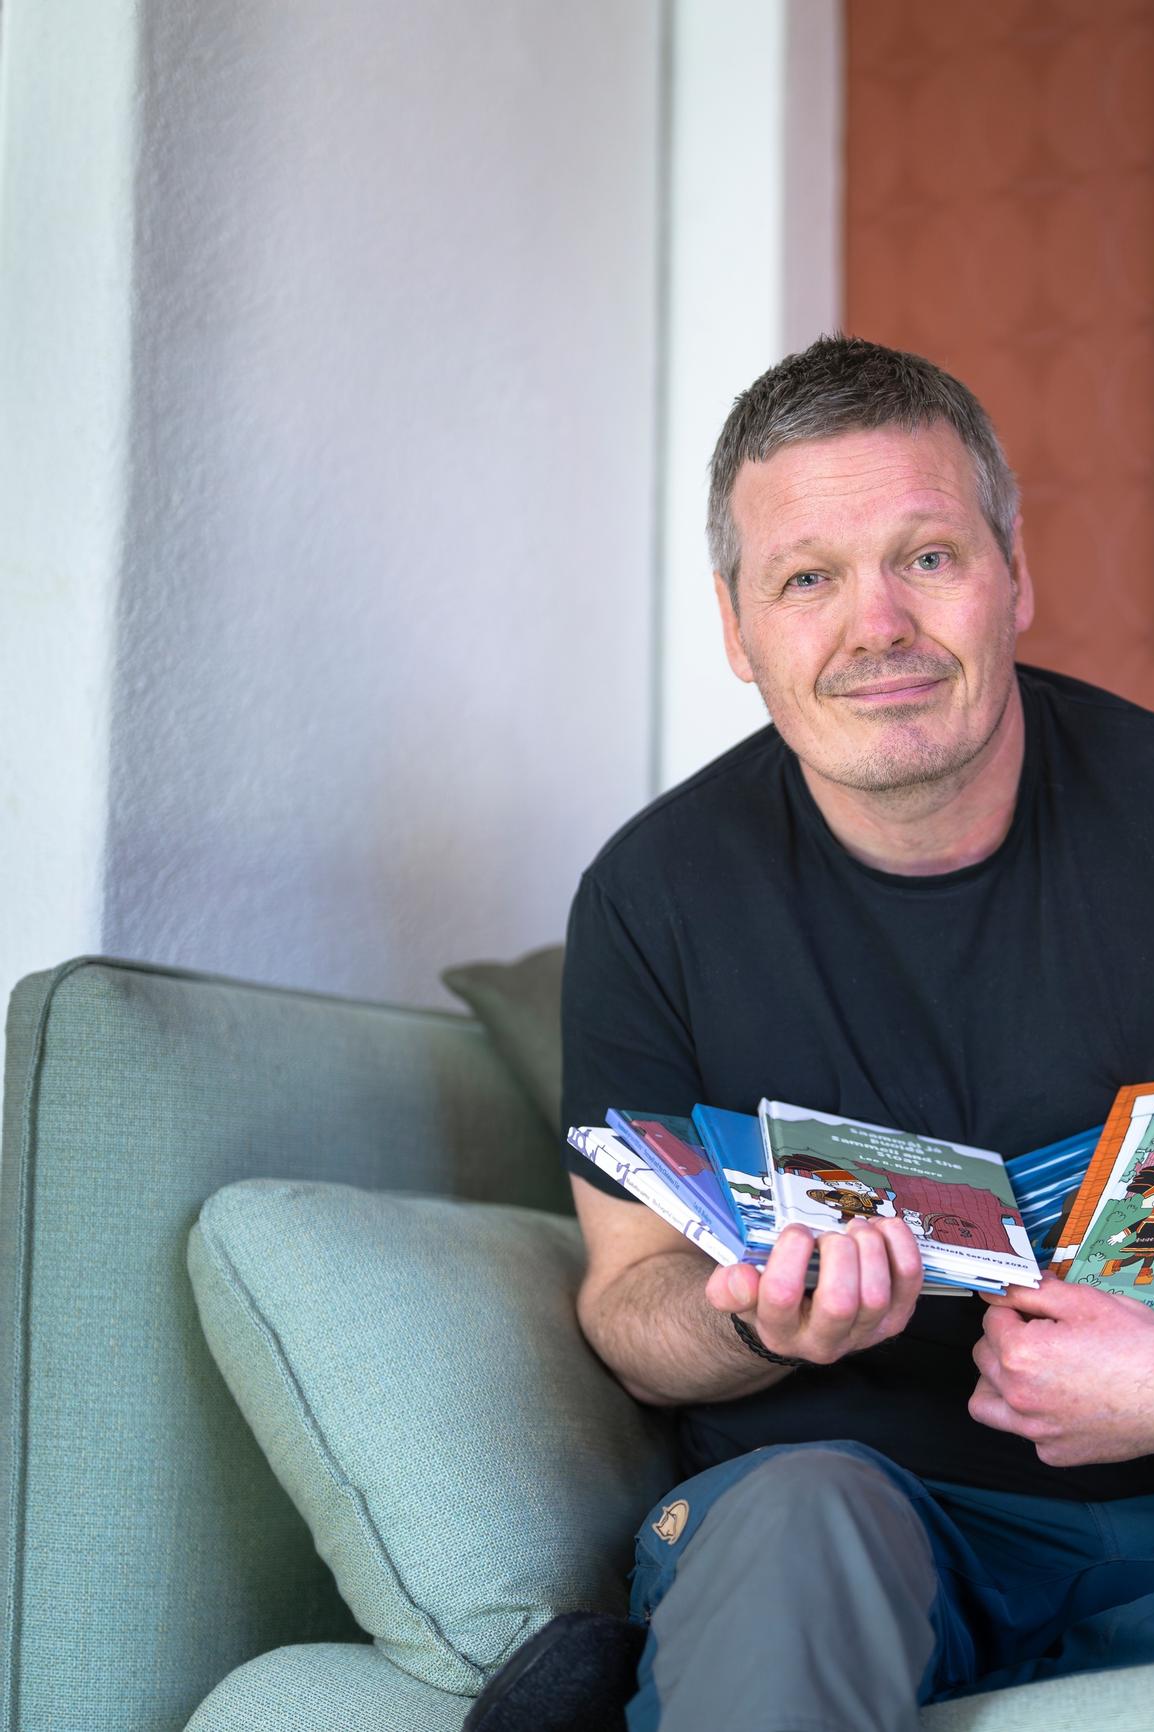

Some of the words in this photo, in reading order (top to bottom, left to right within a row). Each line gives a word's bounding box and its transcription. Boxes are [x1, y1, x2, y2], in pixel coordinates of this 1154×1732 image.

[831, 1135, 899, 1156] Sammeli
[902, 1152, 933, 1164] and
[934, 1159, 963, 1171] the
